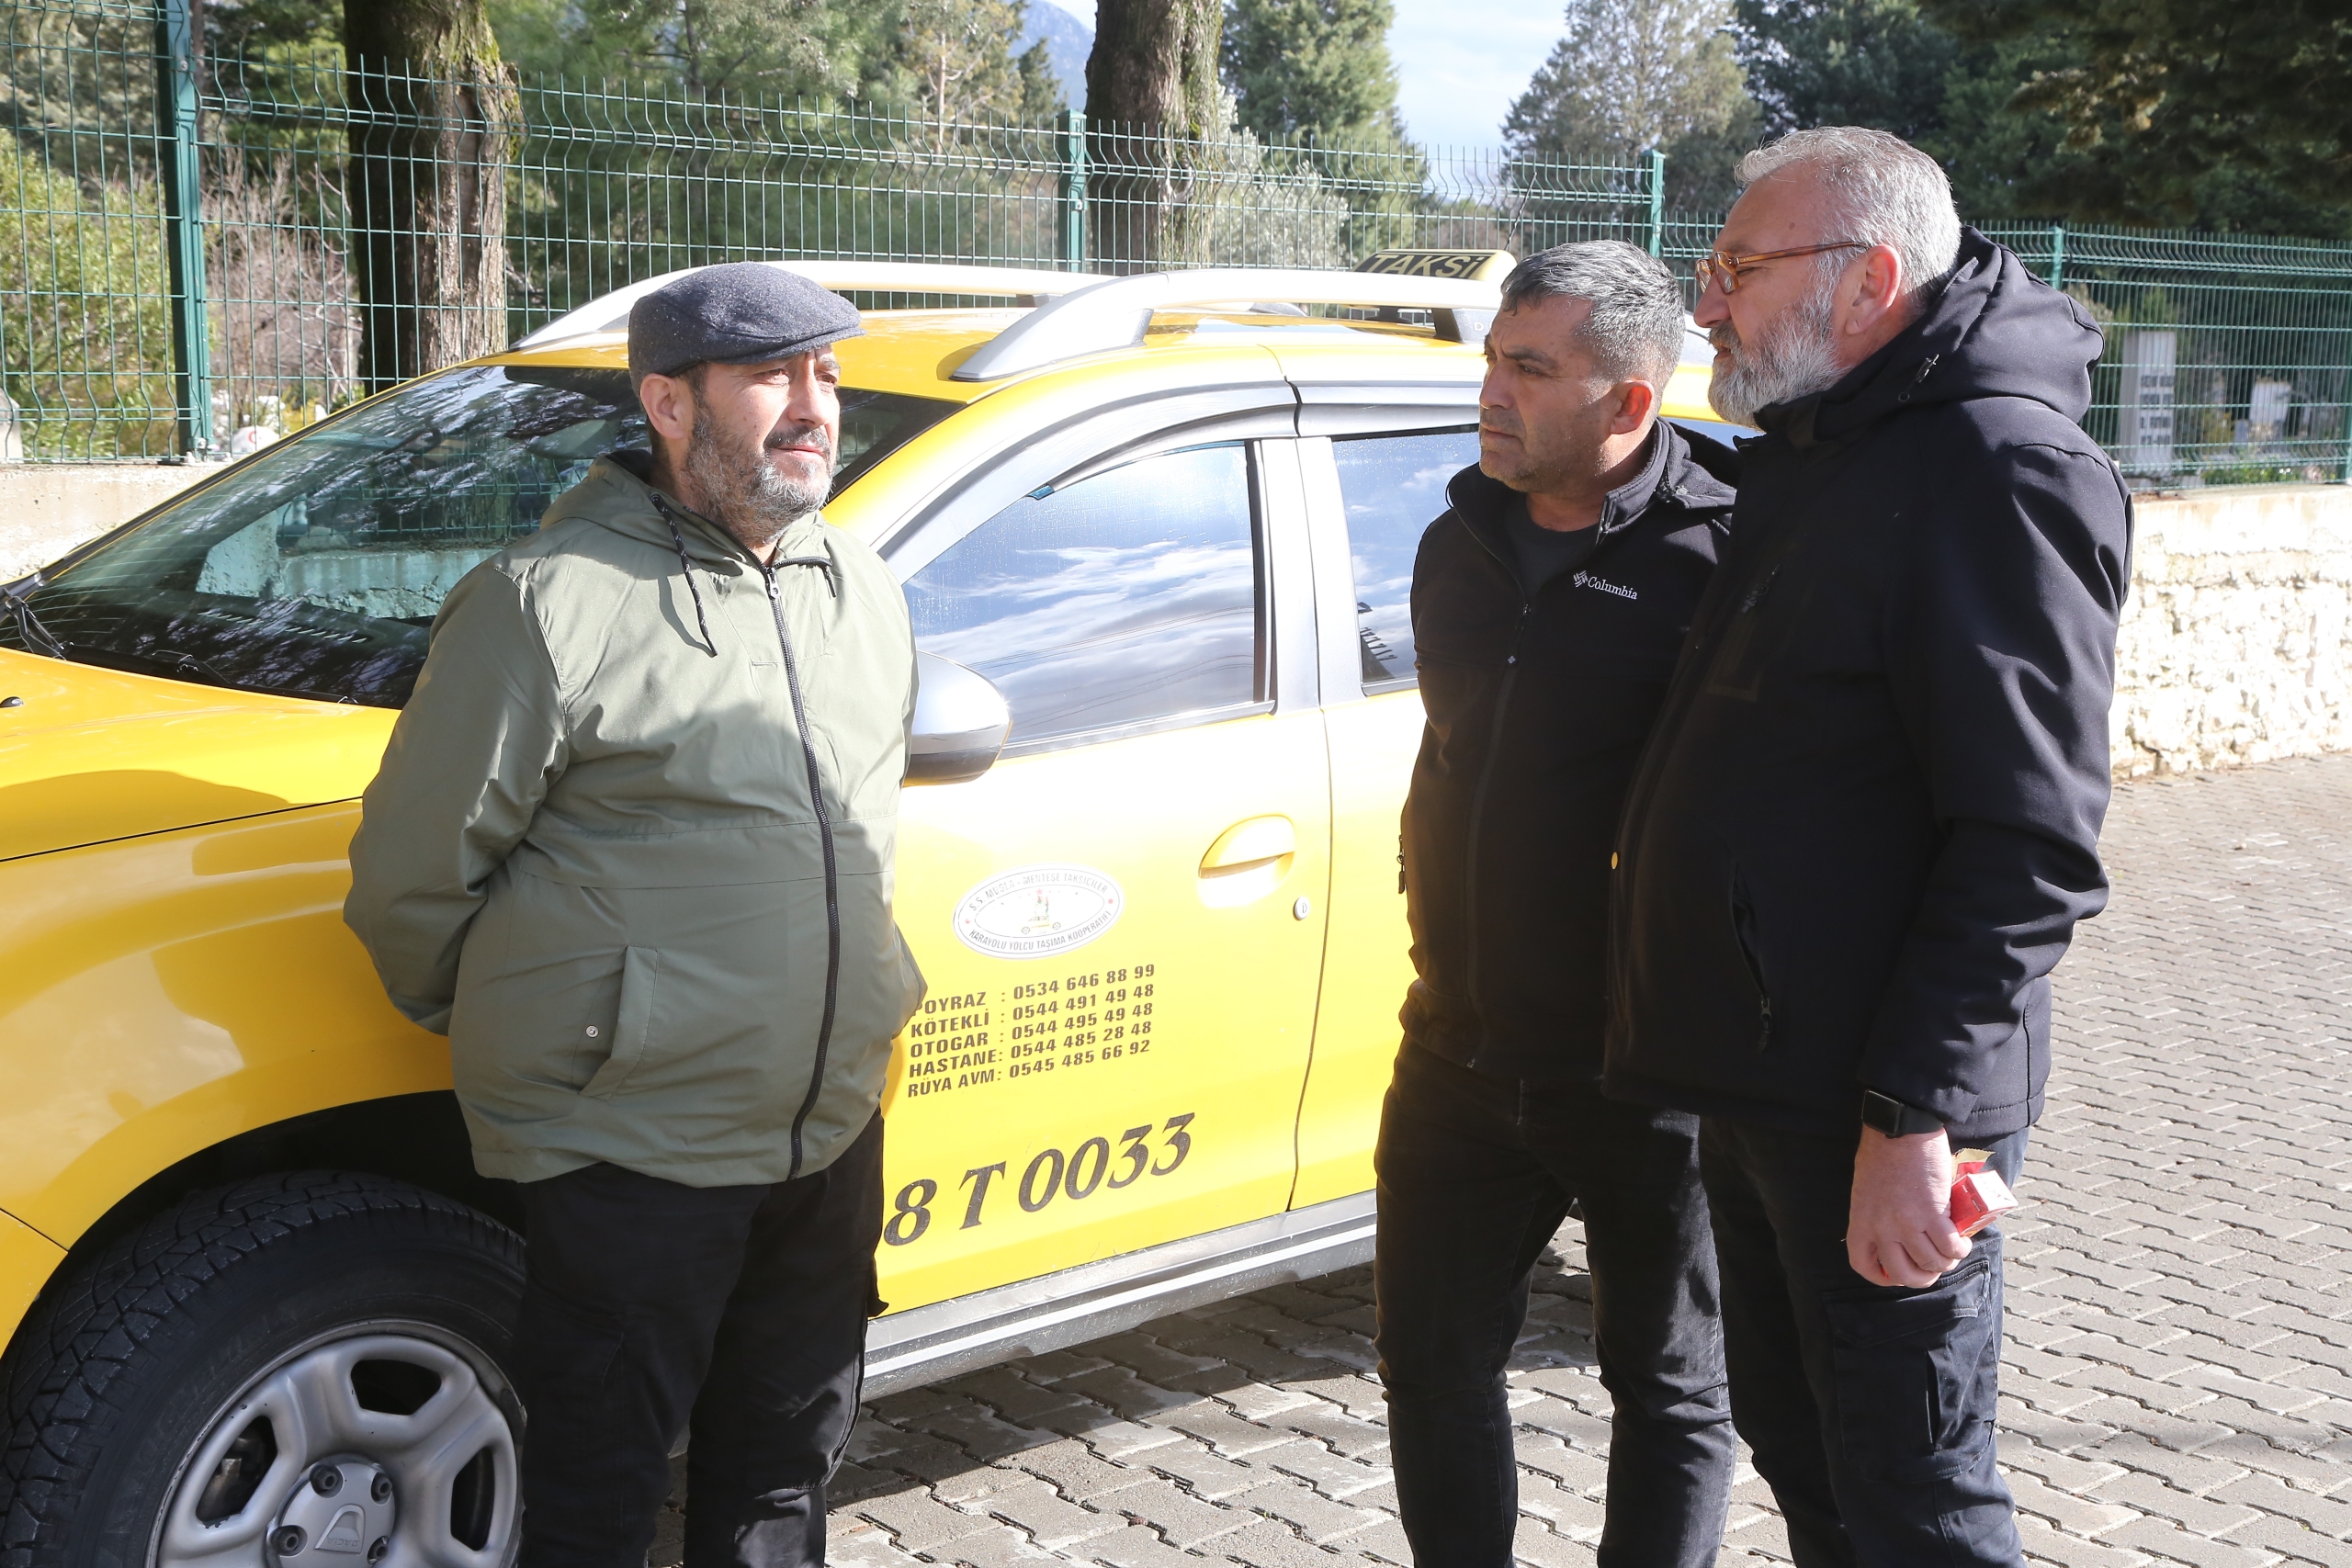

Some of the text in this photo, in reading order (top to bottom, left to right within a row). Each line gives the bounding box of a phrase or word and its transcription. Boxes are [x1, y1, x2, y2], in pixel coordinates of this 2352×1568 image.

[1588, 576, 1638, 600] Columbia
[968, 929, 1007, 950] KARAYOLU
[1009, 941, 1035, 951] YOLCU
[1036, 935, 1067, 950] TAŞIMA
[1013, 980, 1059, 999] 0534
[1067, 973, 1099, 991] 646
[1106, 968, 1127, 984] 88
[1134, 964, 1155, 979] 99
[910, 1008, 989, 1038] KÖTEKLİ
[1012, 1000, 1058, 1021] 0544
[1066, 994, 1096, 1010] 491
[1105, 988, 1126, 1003] 49
[1133, 984, 1154, 998] 48
[910, 1032, 989, 1057] OTOGAR
[1012, 1020, 1057, 1040] 0544
[1064, 1012, 1097, 1030] 495
[1104, 1008, 1125, 1022] 49
[1132, 1002, 1153, 1017] 48
[1011, 1039, 1057, 1059] 0544
[1063, 1031, 1096, 1048] 485
[1102, 1026, 1125, 1042] 28
[1130, 1021, 1151, 1035] 48
[908, 1077, 952, 1098] RÜYA
[1009, 1057, 1055, 1078] 0545
[1061, 1050, 1094, 1067] 485
[1102, 1044, 1123, 1060] 66
[1129, 1039, 1150, 1055] 92
[883, 1111, 1195, 1247] 8 T 0033
[327, 1537, 359, 1547] DACIA
